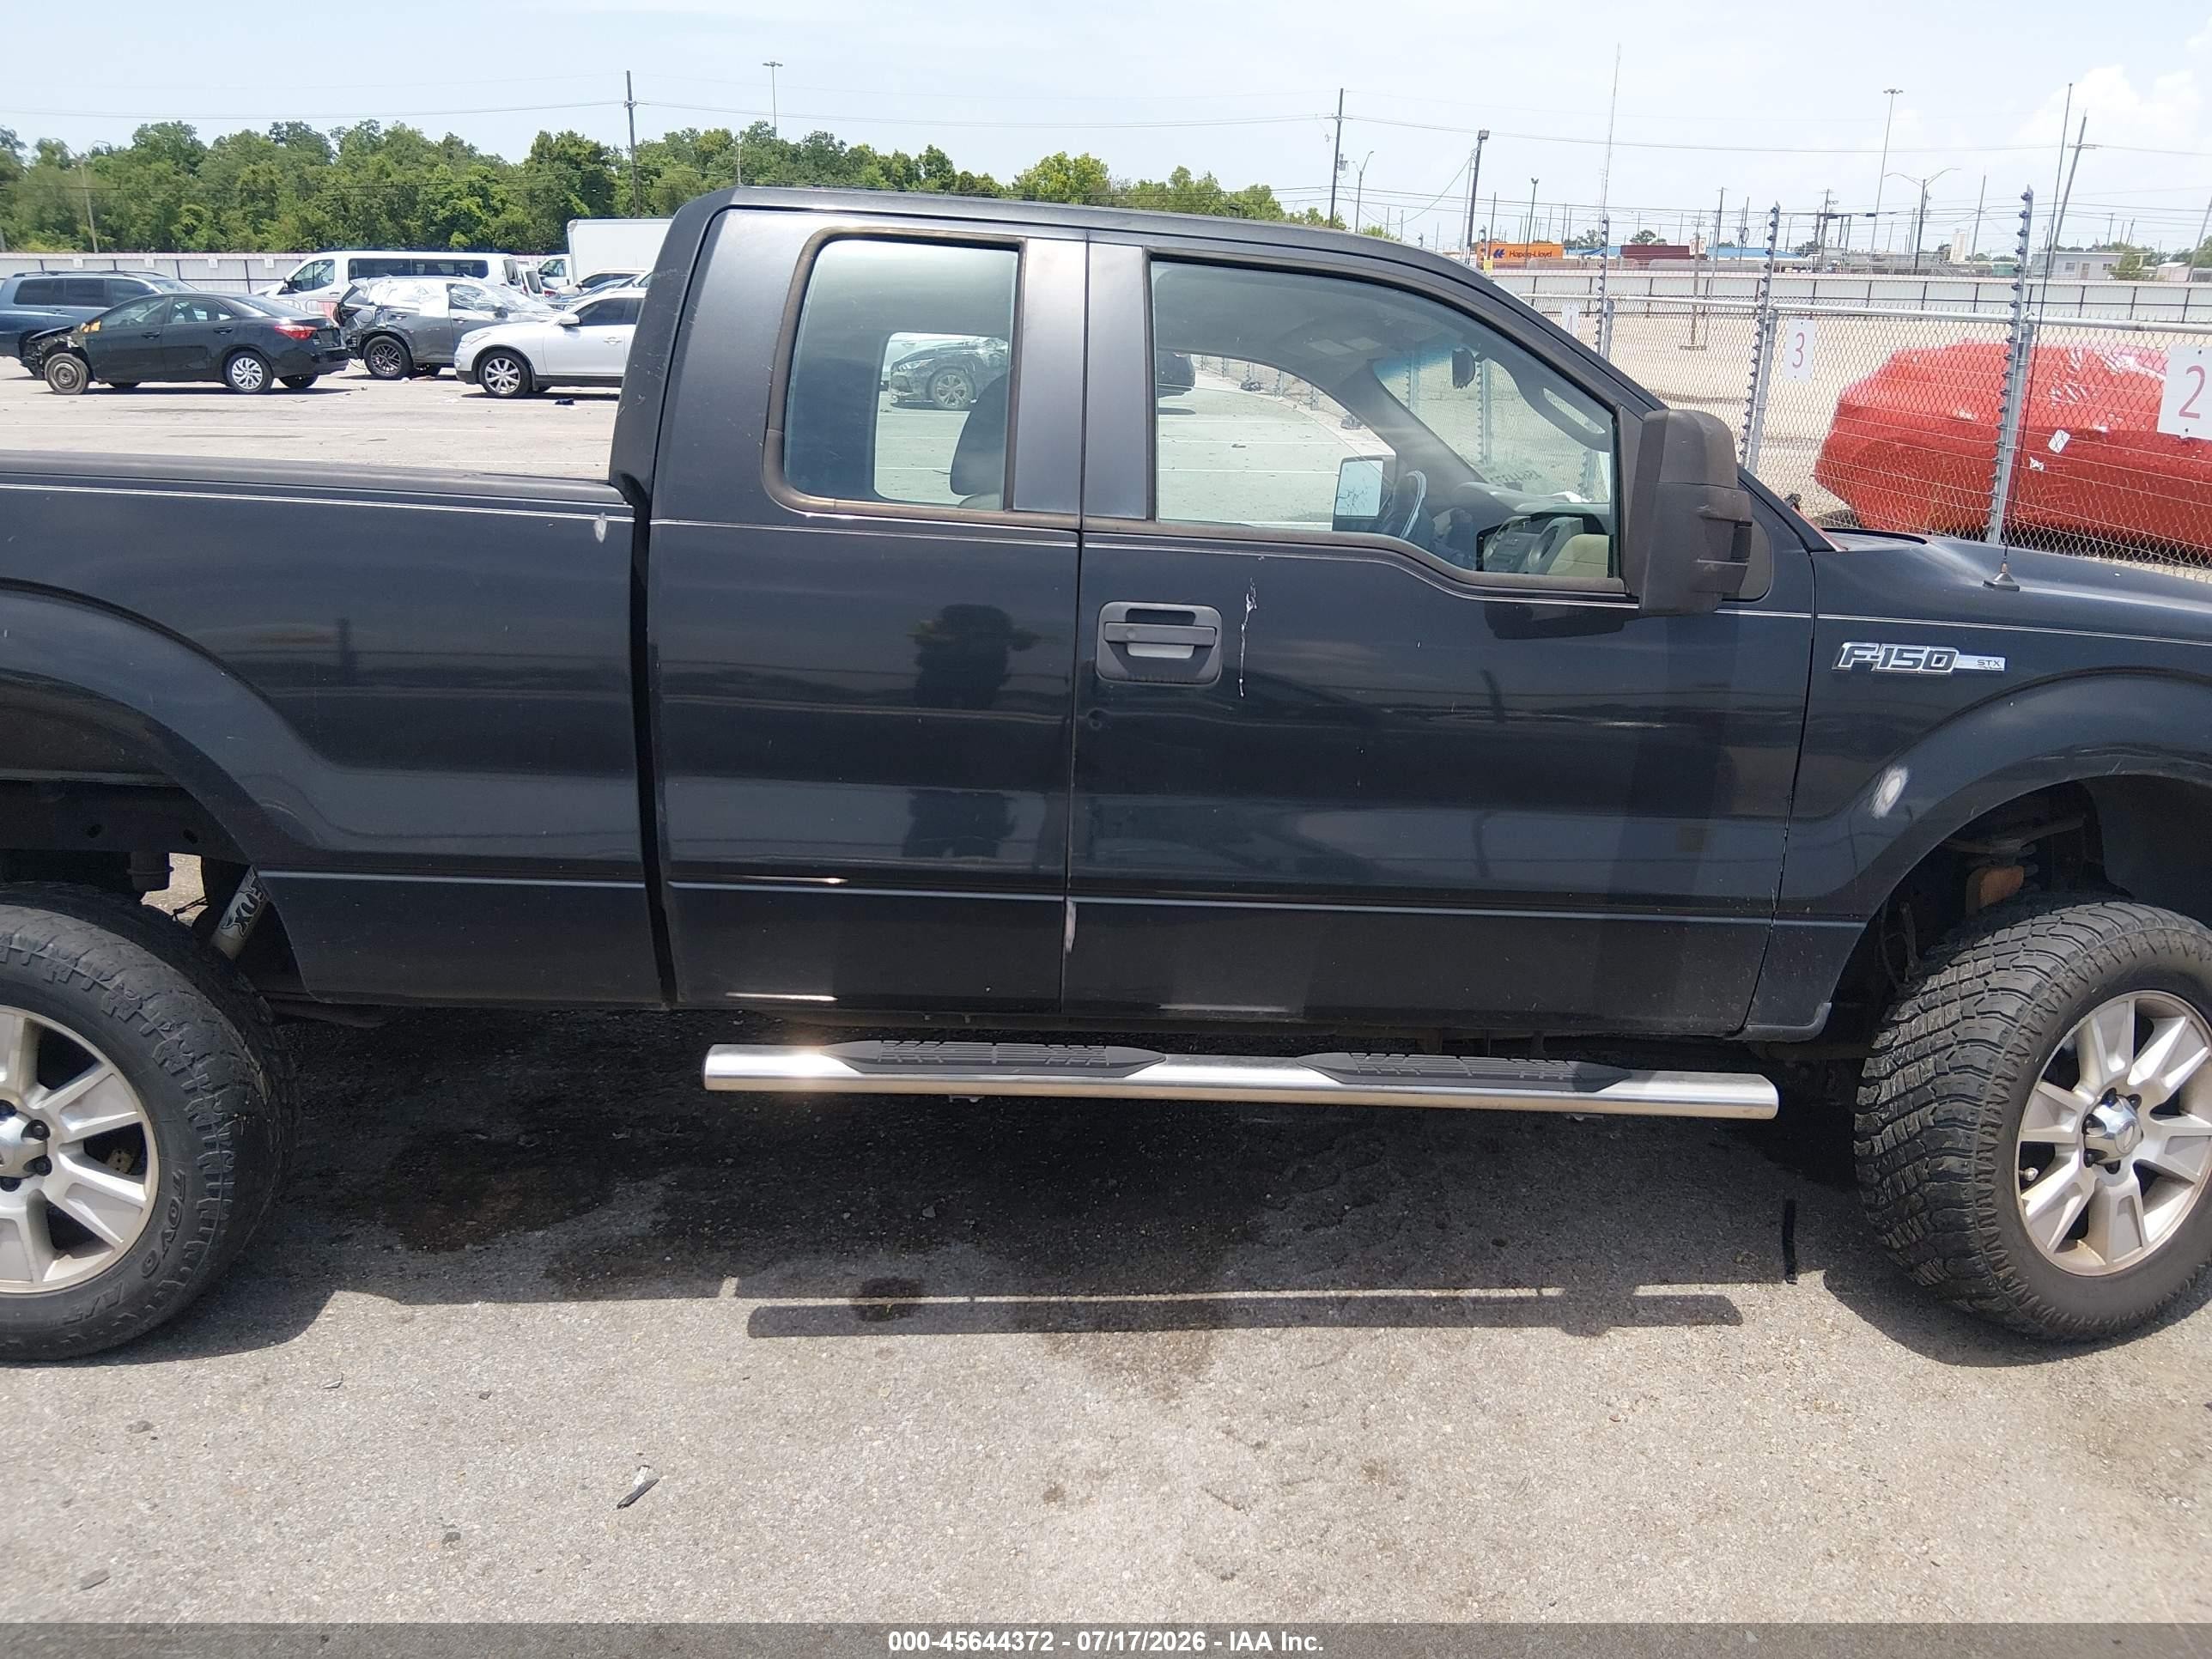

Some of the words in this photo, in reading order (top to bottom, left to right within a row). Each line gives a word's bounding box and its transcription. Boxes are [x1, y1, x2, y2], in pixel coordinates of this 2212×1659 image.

[1792, 332, 1805, 368] 3
[2179, 365, 2205, 419] 2
[1832, 642, 1960, 673] F-150
[1977, 659, 2001, 667] STX
[141, 1169, 186, 1279] TOYO
